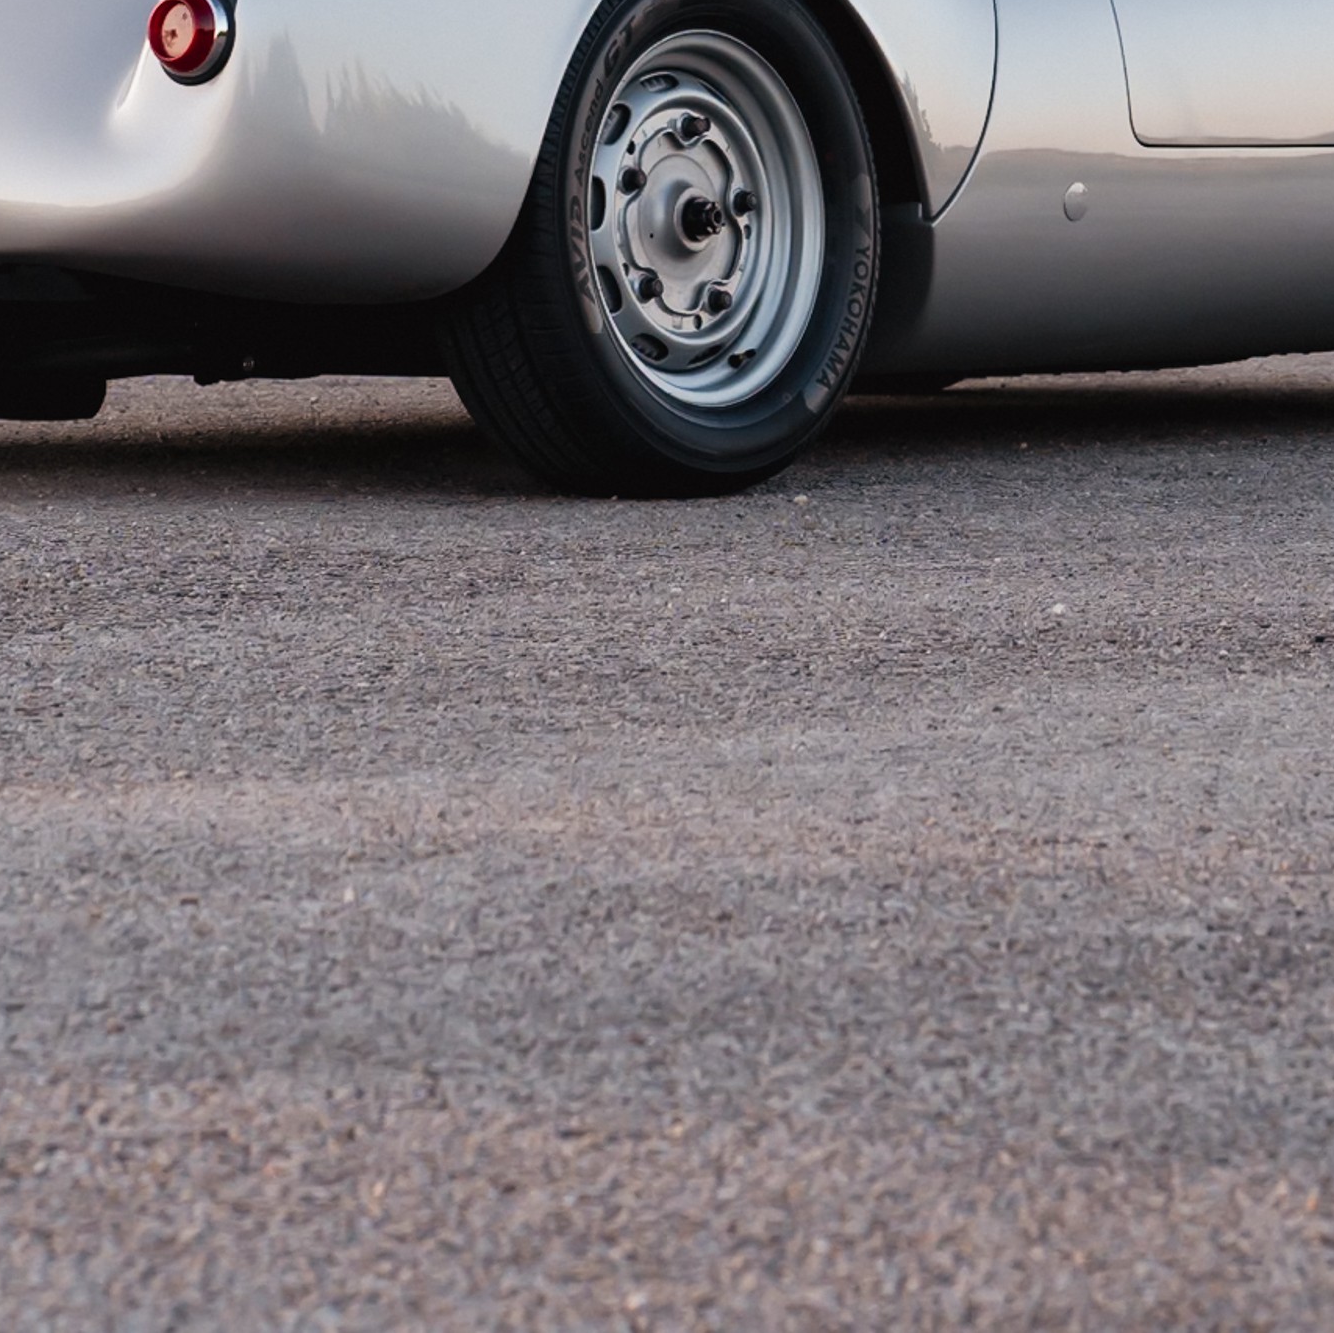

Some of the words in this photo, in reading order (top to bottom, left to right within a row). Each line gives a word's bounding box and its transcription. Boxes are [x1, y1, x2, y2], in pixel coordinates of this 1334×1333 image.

[603, 14, 637, 78] GT
[573, 78, 604, 187] Ascend
[570, 195, 596, 305] AVID
[815, 244, 872, 391] YOKOHAMA
